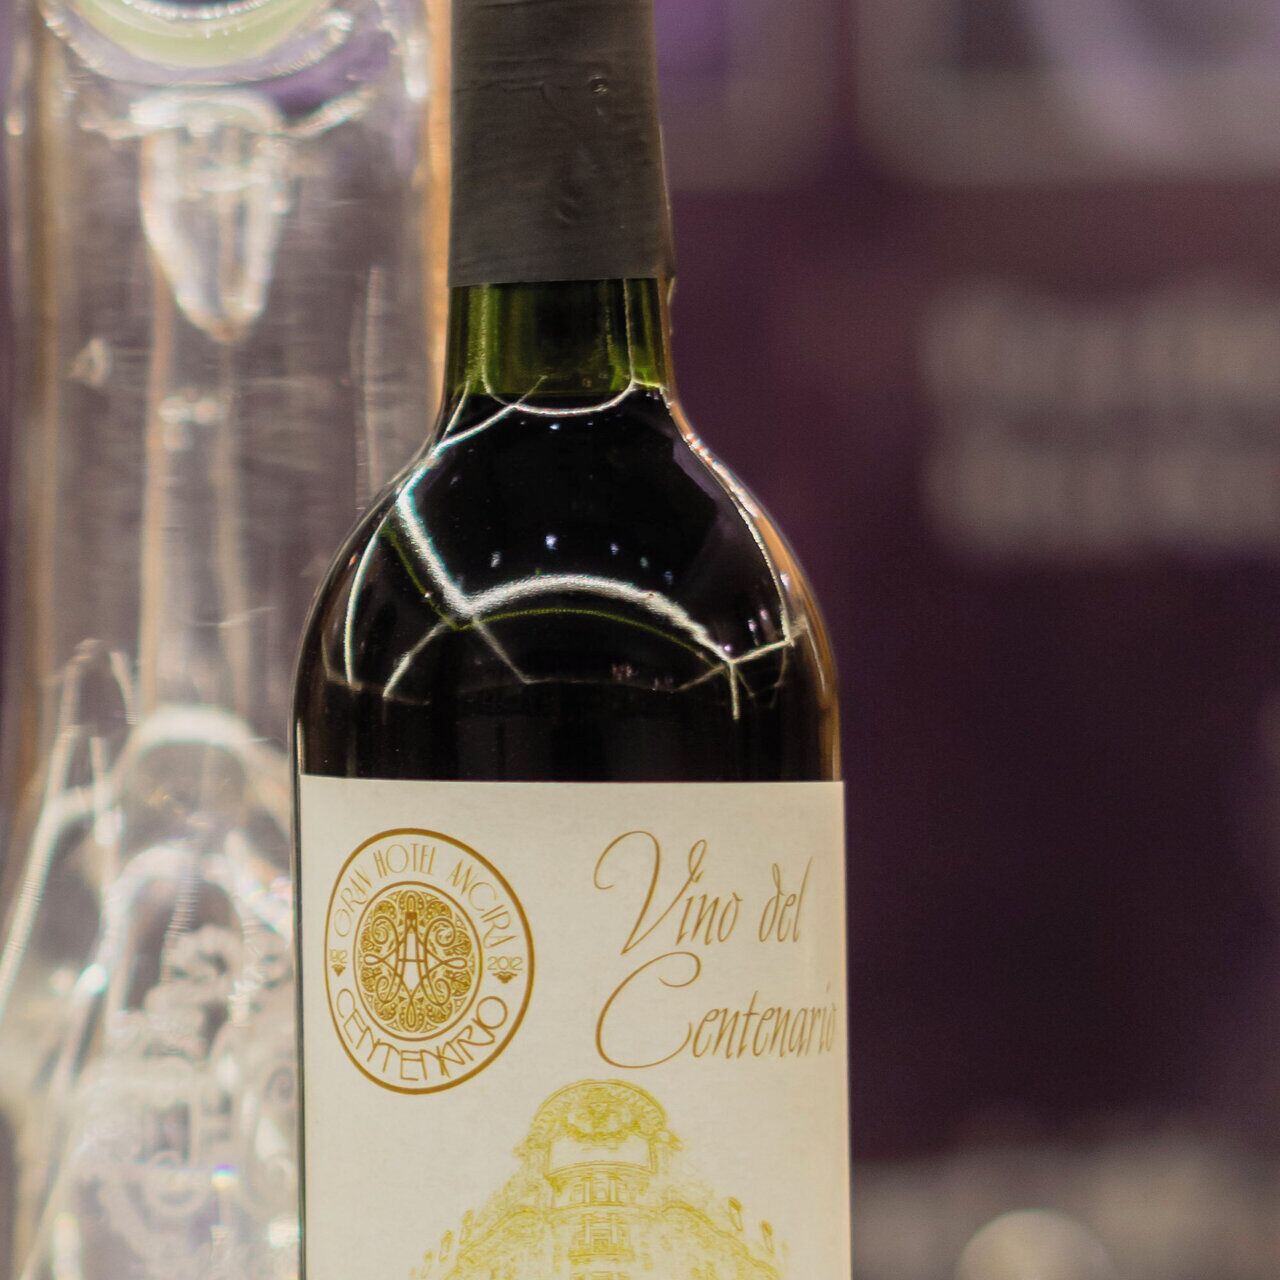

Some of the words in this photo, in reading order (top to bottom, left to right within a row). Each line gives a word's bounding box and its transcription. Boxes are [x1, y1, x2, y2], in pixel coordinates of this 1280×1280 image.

[333, 866, 373, 937] GRAN
[372, 842, 438, 879] HOTEL
[446, 858, 517, 949] ANCIRA
[593, 829, 744, 956] Vino
[758, 855, 814, 944] del
[486, 955, 524, 971] 2012
[594, 951, 838, 1069] Centenario
